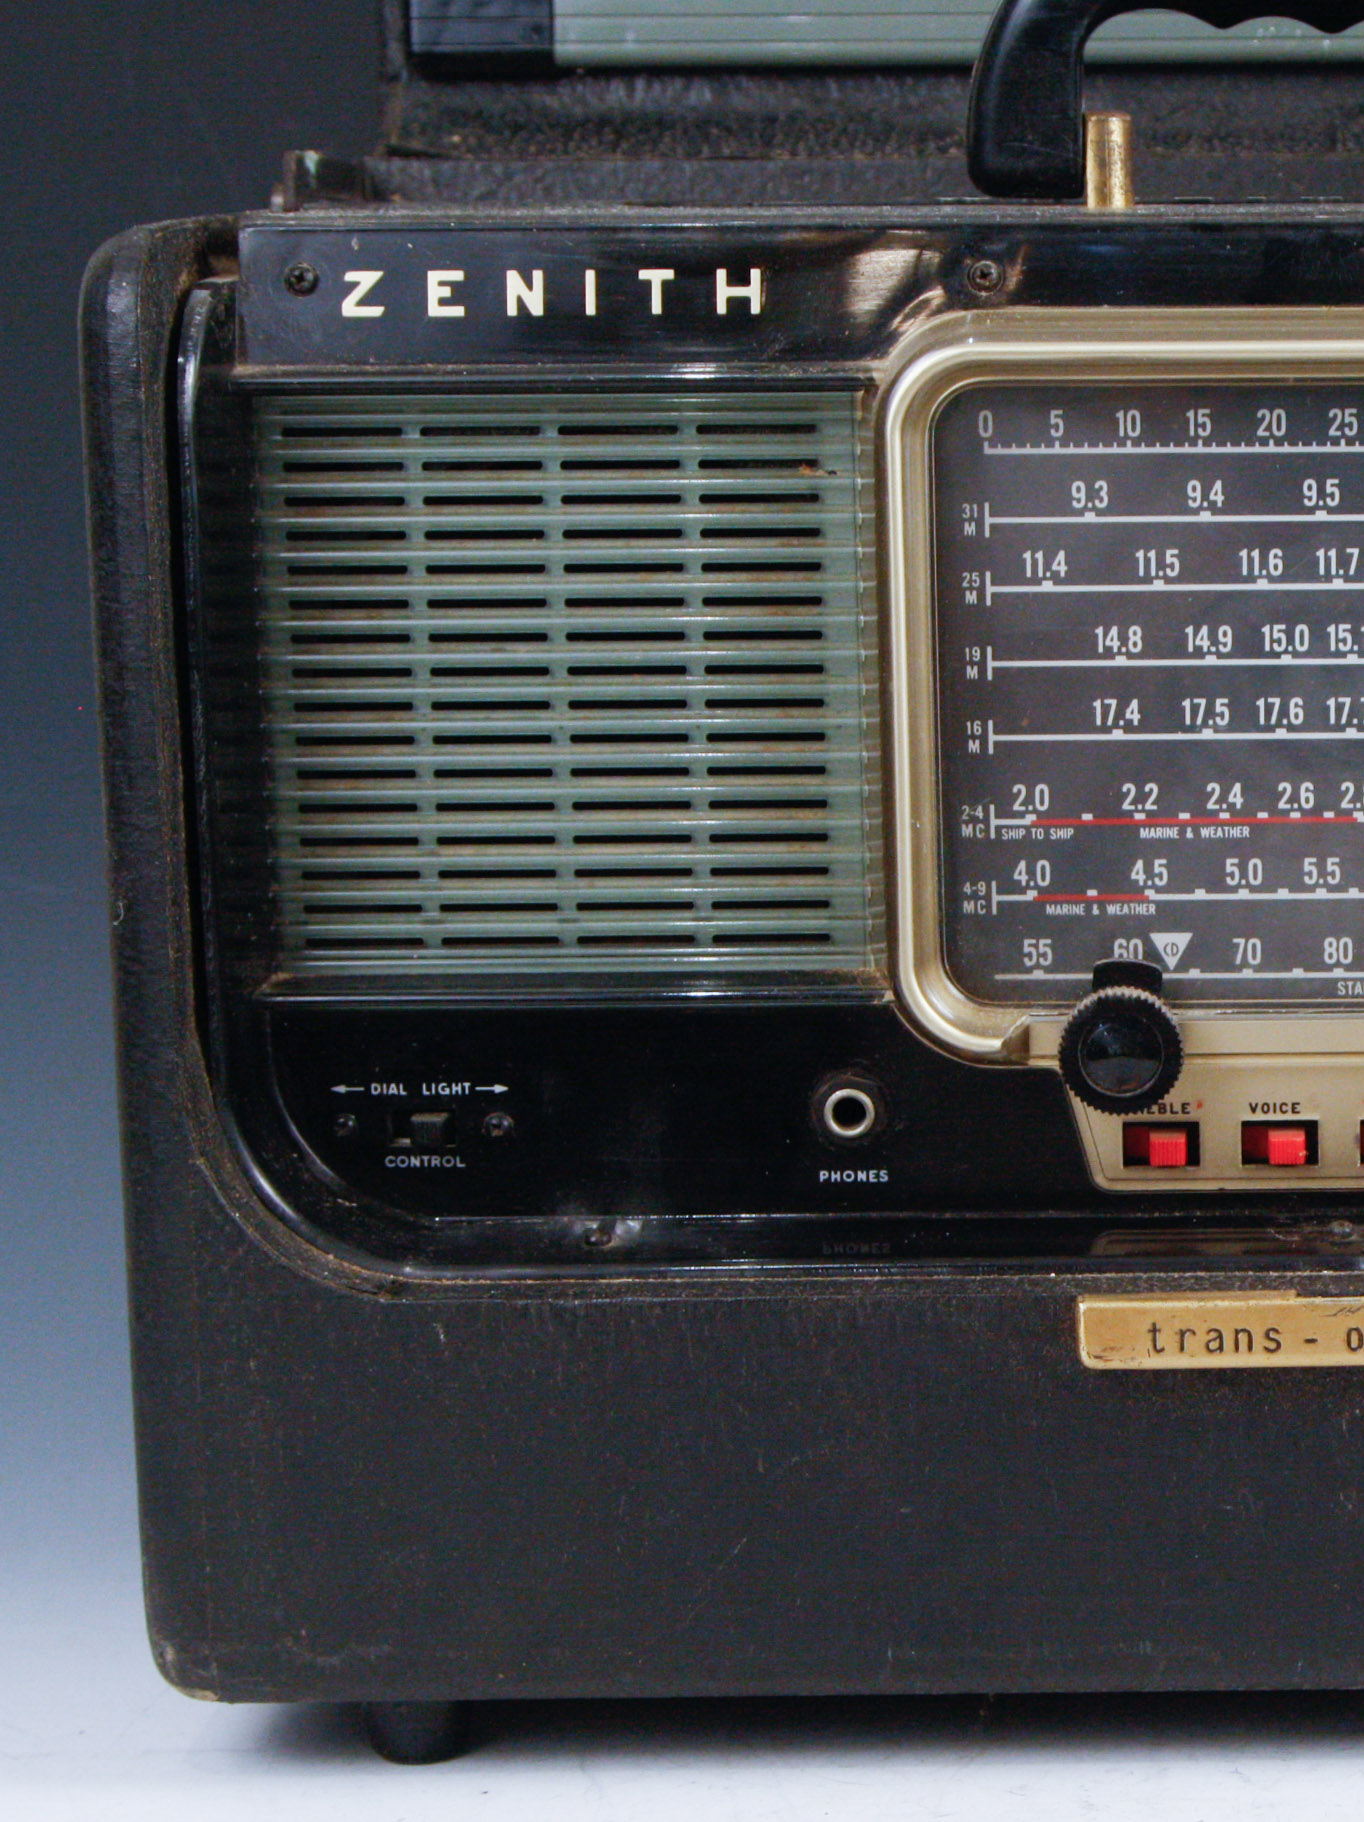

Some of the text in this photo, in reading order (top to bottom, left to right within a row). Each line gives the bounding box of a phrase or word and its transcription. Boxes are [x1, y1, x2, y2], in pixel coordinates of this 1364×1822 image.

[341, 269, 760, 317] ZENITH
[979, 411, 992, 437] 0
[1051, 411, 1063, 437] 5
[1116, 410, 1140, 437] 10
[1187, 409, 1211, 437] 15
[1257, 409, 1286, 436] 20
[1329, 409, 1357, 436] 25
[1072, 481, 1108, 508] 9.3
[1187, 480, 1224, 507] 9.4
[1303, 479, 1339, 506] 9.5
[963, 504, 977, 518] 31
[964, 522, 975, 535] M
[1023, 550, 1067, 577] 11.4
[1136, 549, 1179, 576] 11.5
[1239, 549, 1283, 576] 11.6
[1316, 548, 1359, 575] 11.7
[963, 572, 980, 587] 25
[966, 590, 977, 604] M
[1095, 626, 1142, 653] 14.8
[1185, 625, 1232, 652] 14.9
[1262, 624, 1309, 651] 15.0
[966, 647, 980, 661] 19
[967, 665, 978, 679] M
[1093, 699, 1140, 725] 17.4
[1182, 698, 1229, 726] 17.5
[1256, 697, 1303, 724] 17.6
[967, 721, 981, 735] 16
[969, 740, 979, 753] M
[1013, 784, 1049, 811] 2.0
[1122, 783, 1158, 810] 2.2
[1207, 783, 1243, 809] 2.4
[1278, 782, 1314, 809] 2.6
[962, 805, 983, 819] 2-4
[962, 824, 984, 838] MC
[1002, 828, 1073, 839] SHIP TO SHIP
[1140, 826, 1249, 838] MARINE & WEATHER
[1014, 860, 1050, 886] 4.0
[1131, 859, 1168, 886] 4.5
[1226, 858, 1262, 885] 5.0
[1304, 858, 1340, 884] 5.5
[964, 881, 985, 895] 4-9
[963, 900, 986, 914] MC
[1046, 903, 1155, 915] MARINE & WEATHER
[1024, 939, 1052, 966] 55
[1114, 938, 1142, 960] 60
[1233, 938, 1261, 964] 70
[1324, 937, 1352, 964] 80
[371, 1082, 470, 1095] DIAL LIGHT
[1249, 1102, 1300, 1114] VOICE
[385, 1156, 465, 1167] CONTROL
[820, 1170, 888, 1182] PHONES
[1147, 1321, 1284, 1357] trans
